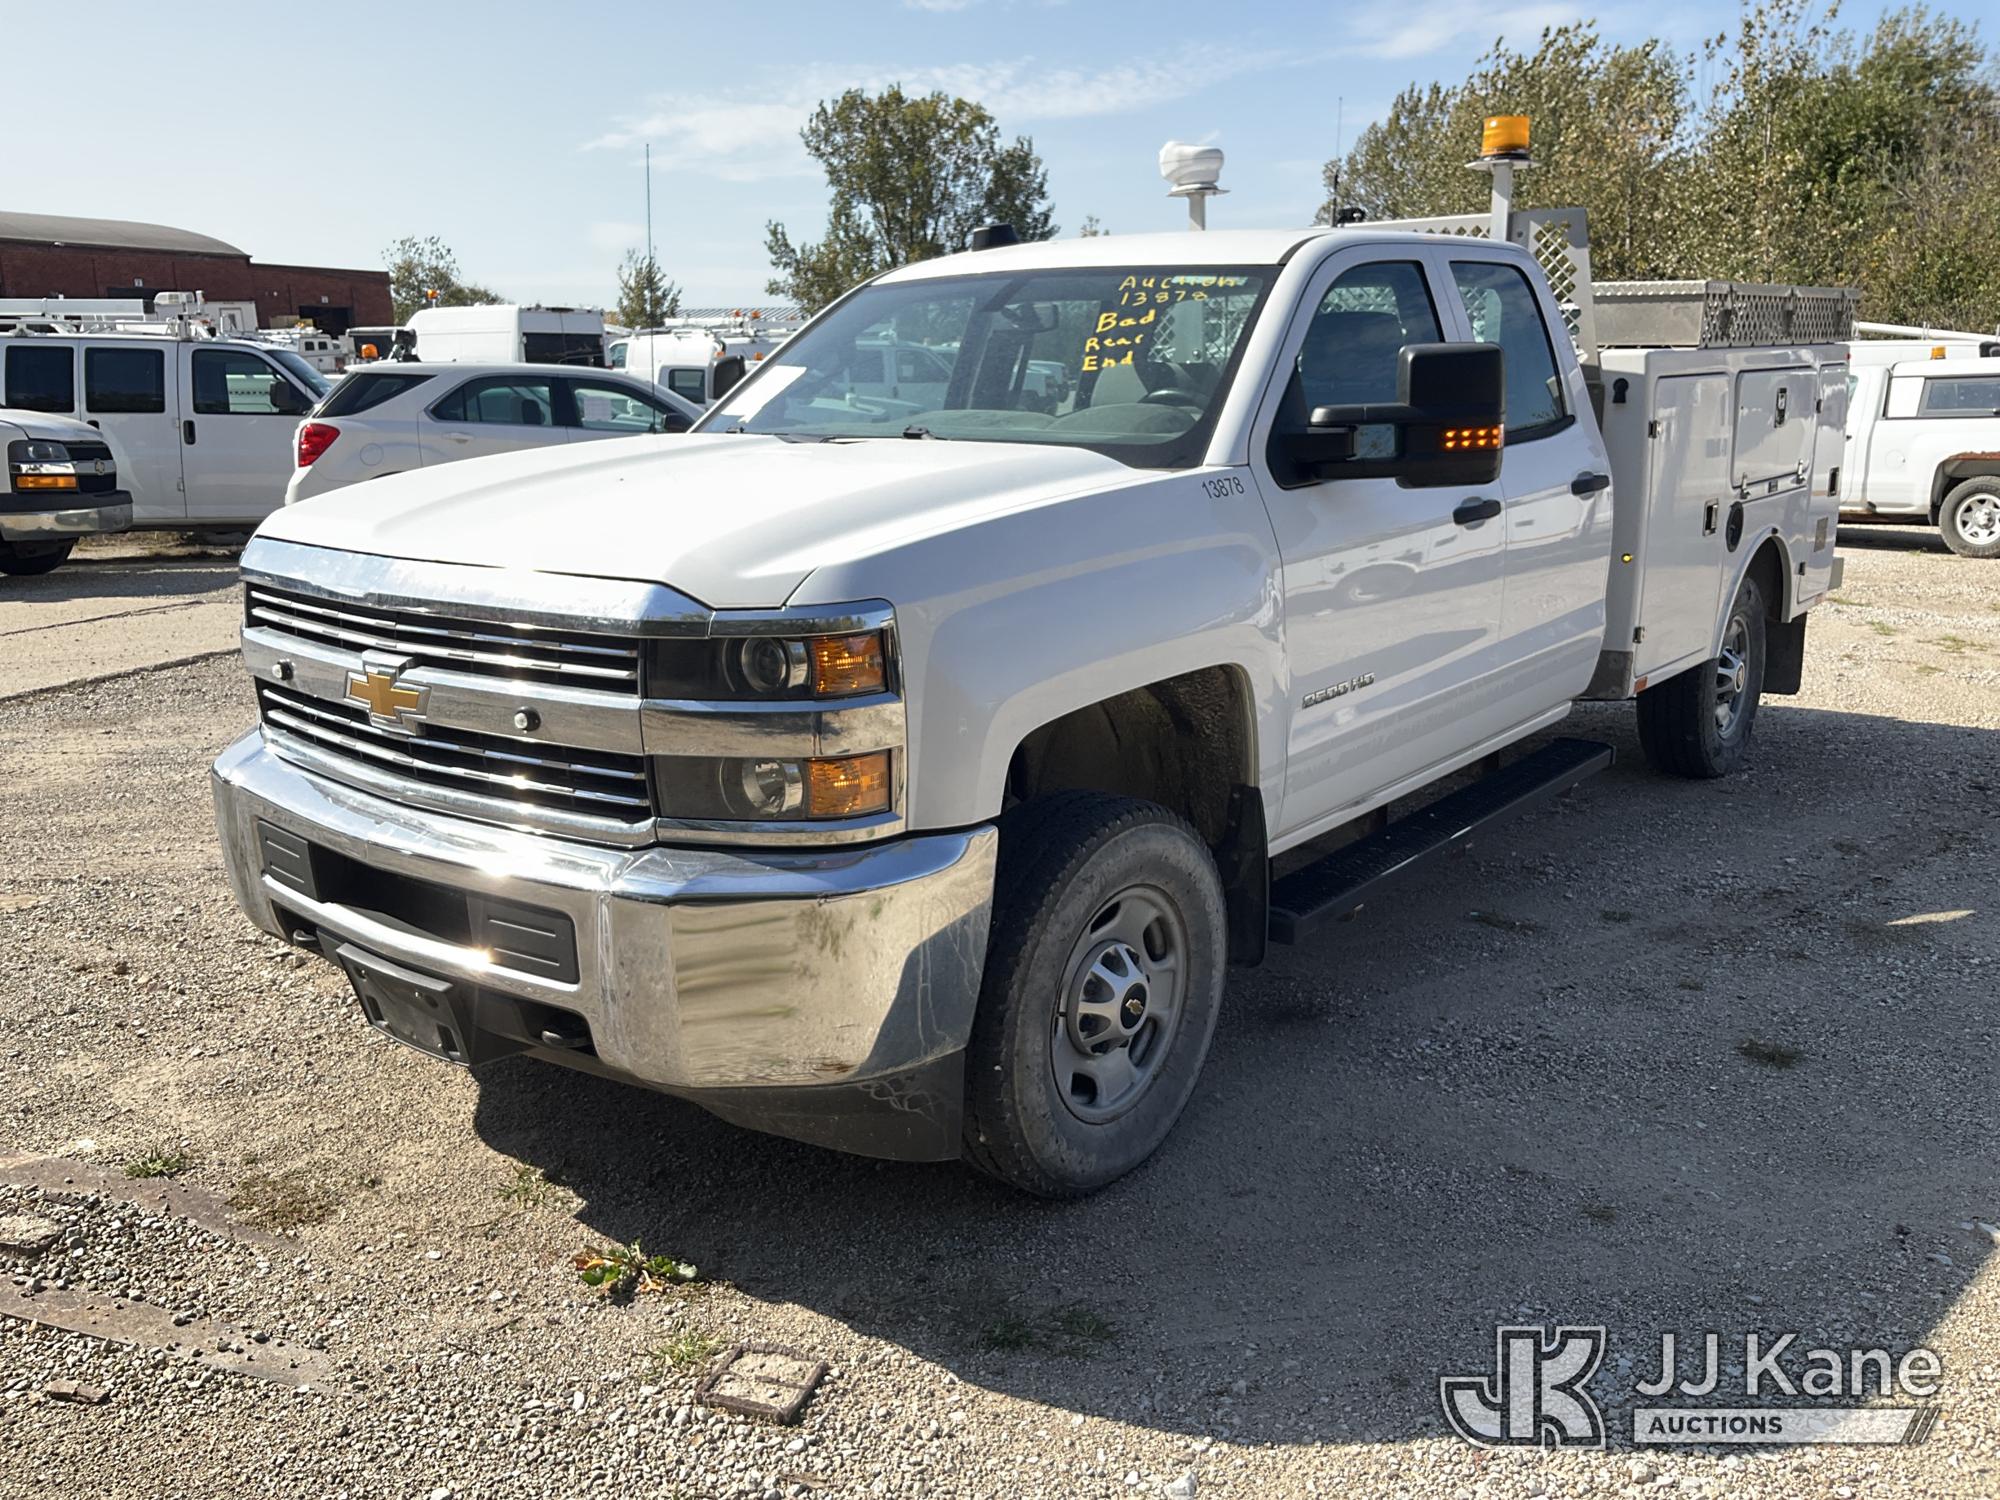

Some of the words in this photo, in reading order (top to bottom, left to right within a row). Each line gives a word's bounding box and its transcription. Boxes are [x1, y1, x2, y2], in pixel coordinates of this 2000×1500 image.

[1120, 290, 1209, 306] 13878
[1096, 308, 1157, 333] Bad
[1085, 333, 1145, 352] Rear
[1081, 350, 1134, 371] End
[1201, 476, 1246, 499] 13878
